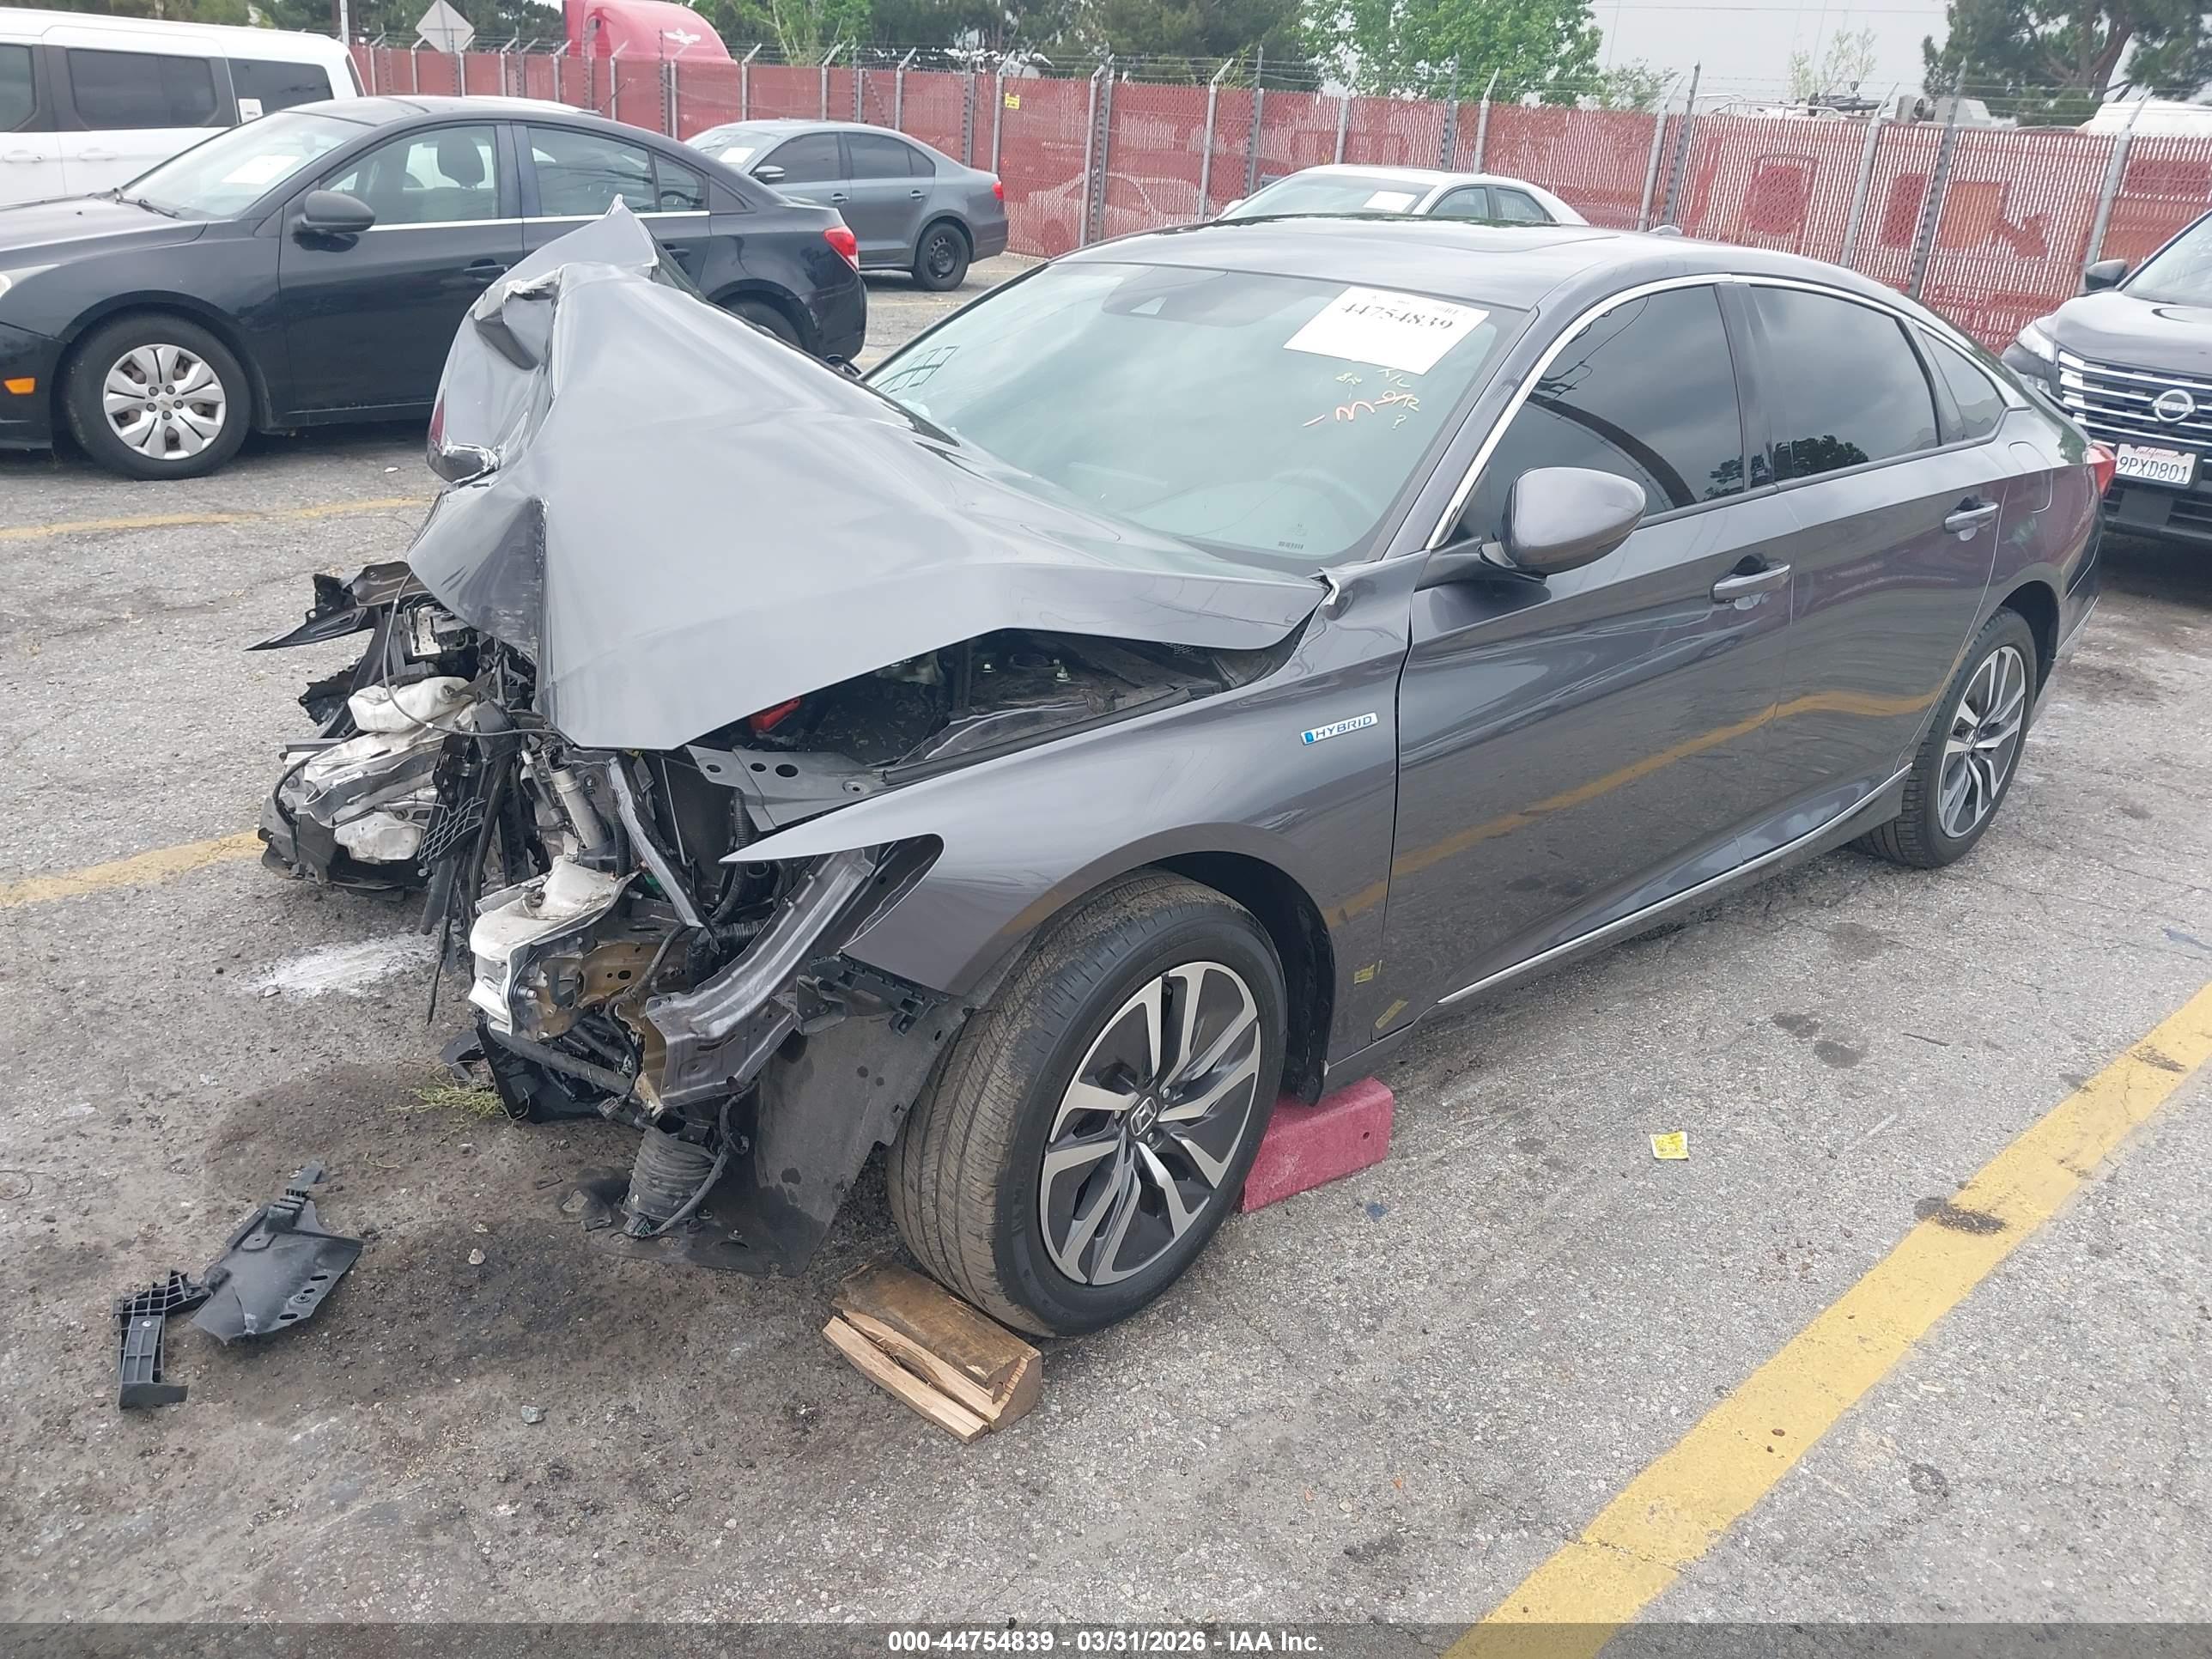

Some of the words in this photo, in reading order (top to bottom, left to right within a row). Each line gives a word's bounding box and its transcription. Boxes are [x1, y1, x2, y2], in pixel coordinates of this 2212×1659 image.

[1340, 302, 1454, 330] 44754839
[2118, 455, 2188, 483] 9PXD801
[1315, 715, 1373, 739] HYBRID
